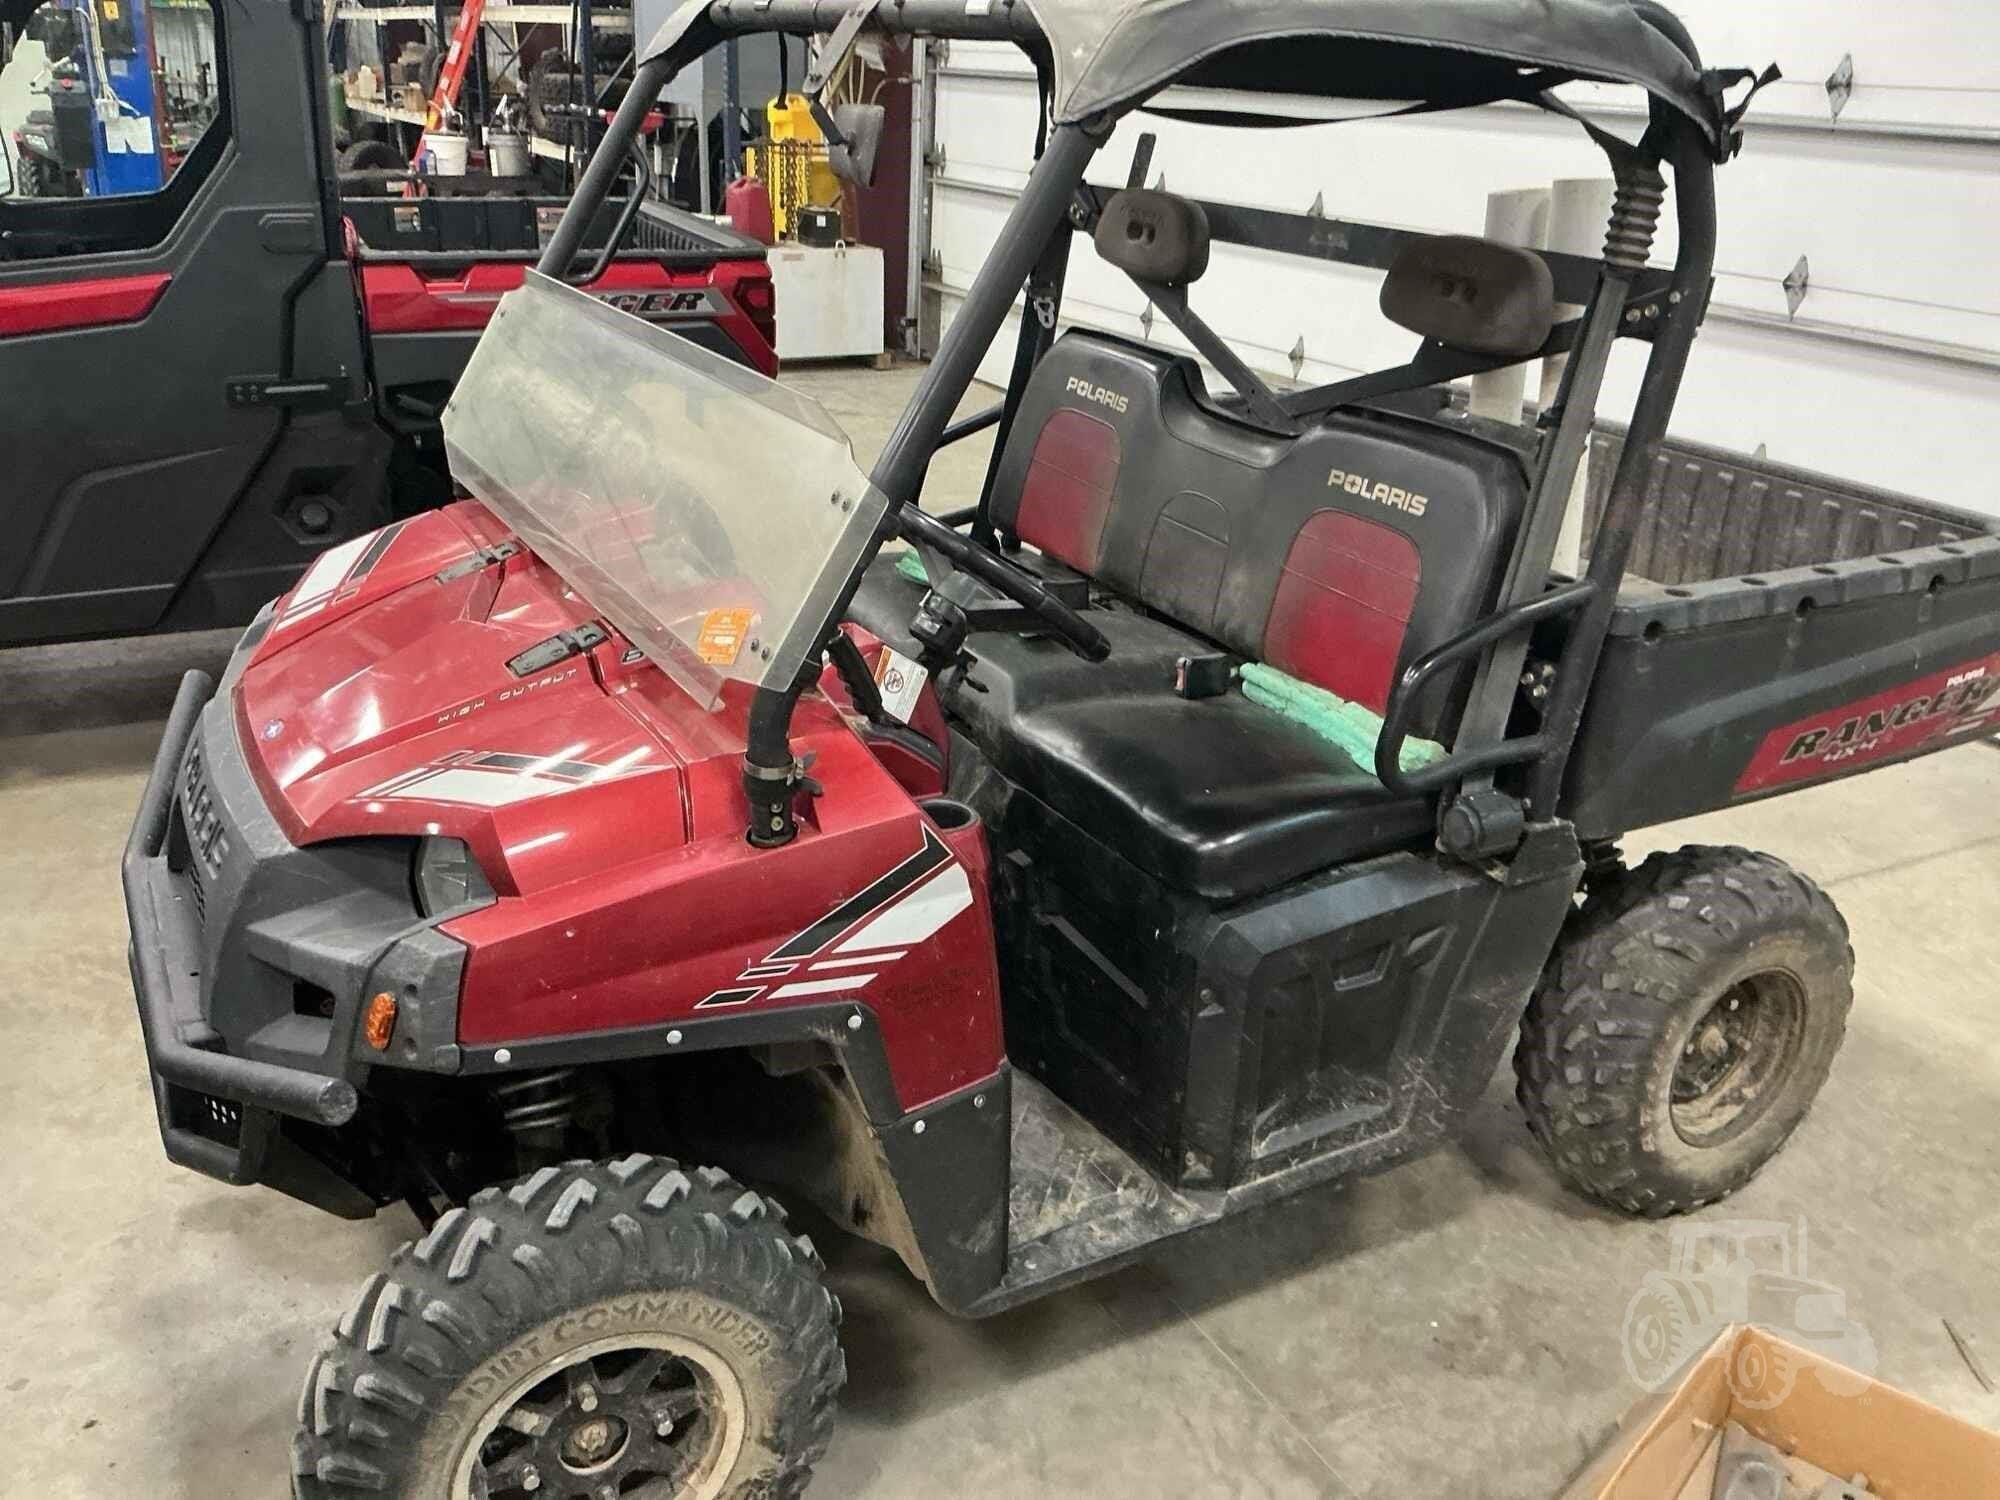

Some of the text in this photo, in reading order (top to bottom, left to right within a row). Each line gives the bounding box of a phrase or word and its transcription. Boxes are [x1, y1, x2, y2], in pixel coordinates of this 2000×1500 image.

[1066, 376, 1129, 413] POLARIS
[1327, 468, 1428, 517] POLARIS
[438, 668, 577, 724] HIGH OUTPUT
[1780, 677, 1990, 765] RANGER
[464, 1300, 771, 1397] DIRT COMMANDER
